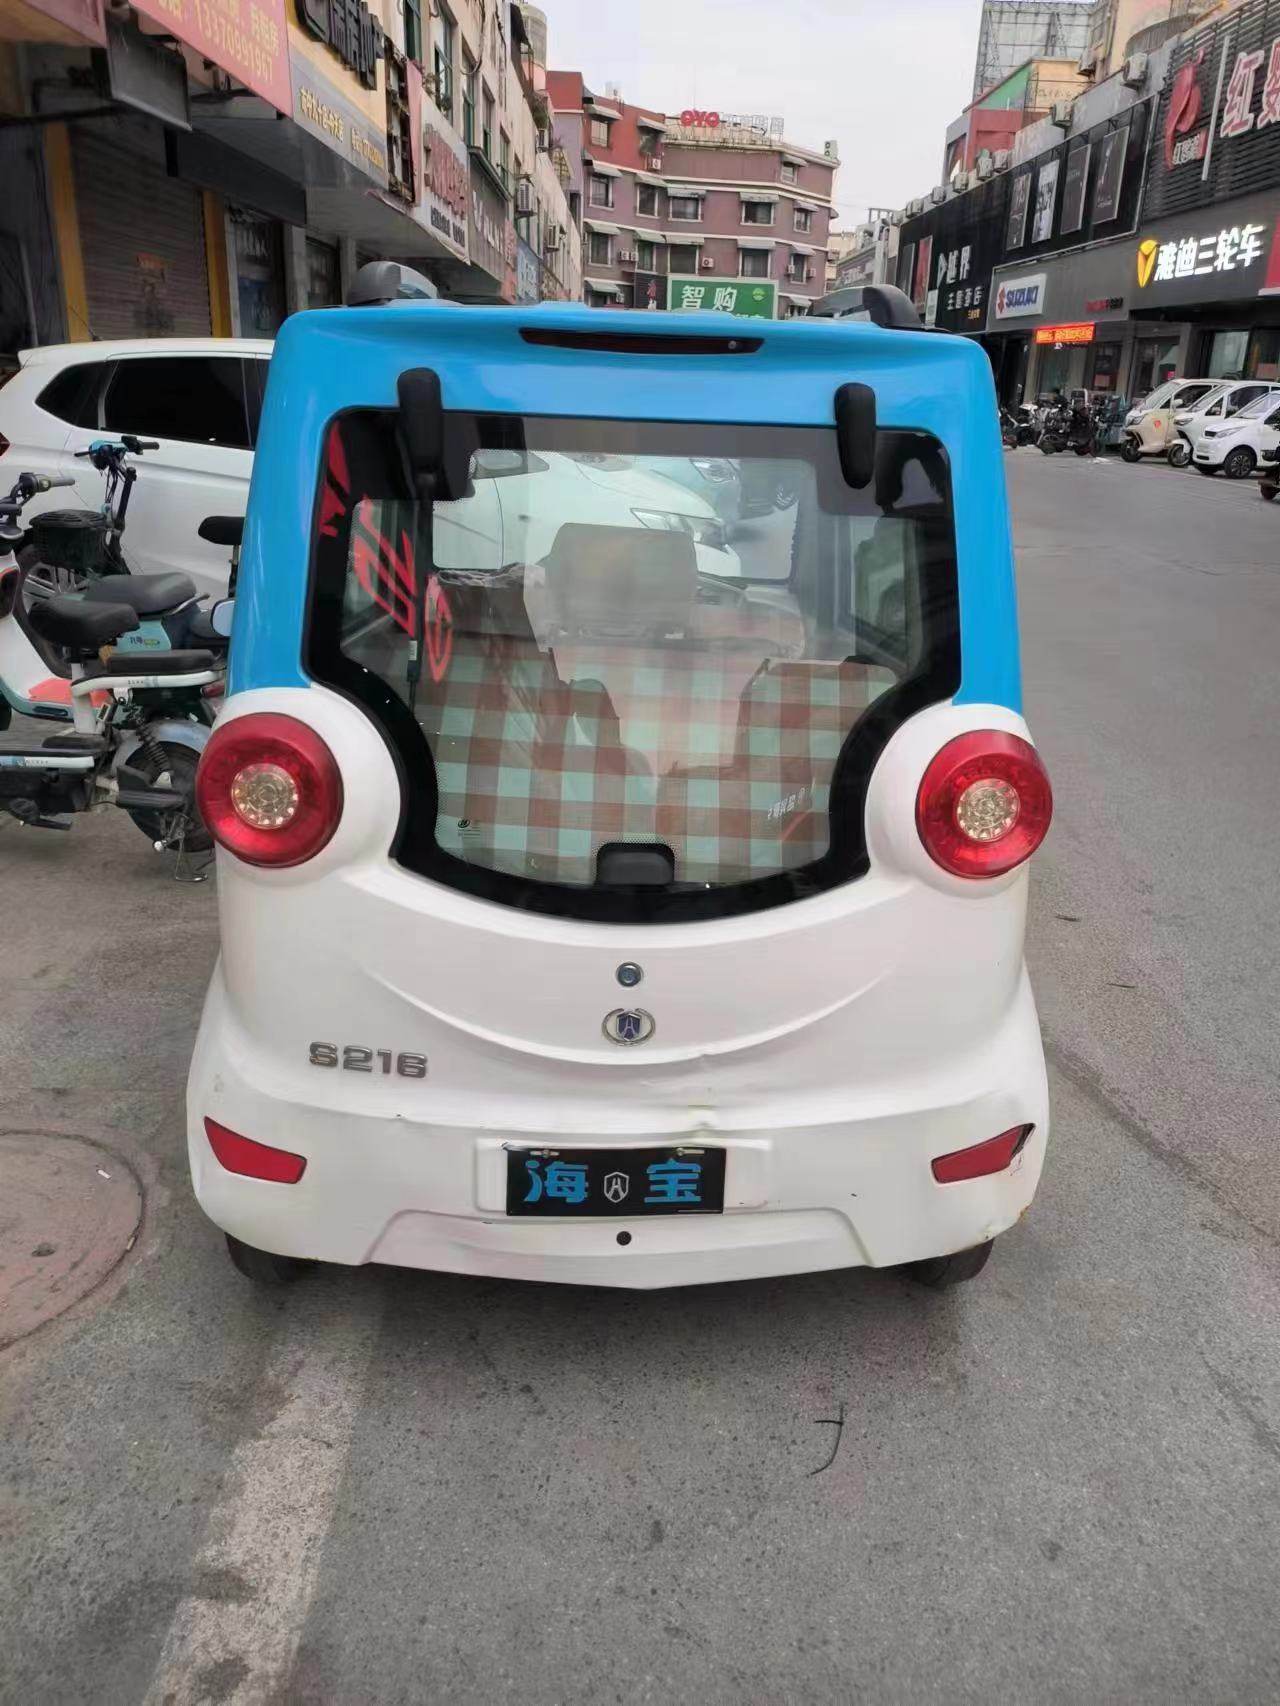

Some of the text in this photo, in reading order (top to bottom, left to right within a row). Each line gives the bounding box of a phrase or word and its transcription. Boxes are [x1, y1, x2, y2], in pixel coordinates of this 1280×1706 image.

[681, 285, 737, 312] 智购
[1005, 286, 1039, 308] SUZUKI
[309, 1041, 428, 1079] S216
[523, 1158, 703, 1204] 海宝
